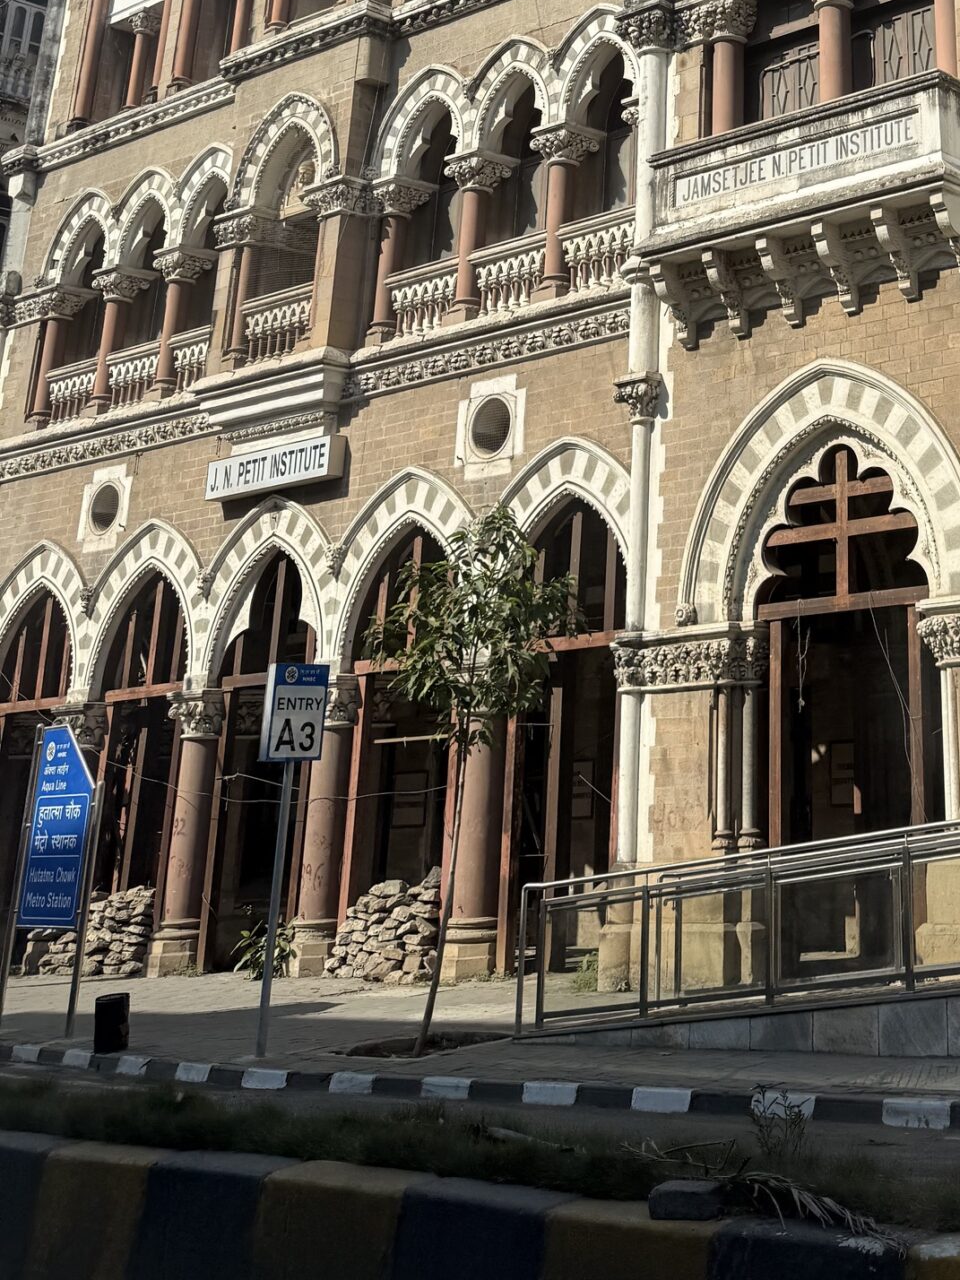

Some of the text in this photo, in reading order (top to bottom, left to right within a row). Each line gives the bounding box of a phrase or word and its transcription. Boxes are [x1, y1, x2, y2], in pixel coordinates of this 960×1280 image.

[682, 160, 766, 202] JAMSETJEE
[789, 141, 829, 174] PETIT
[835, 118, 913, 161] INSTITUTE
[210, 443, 326, 493] J. N. PETIT INSTITUTE
[277, 697, 323, 711] ENTRY
[274, 718, 316, 752] A3
[41, 780, 67, 792] Aqua Line
[37, 799, 82, 827] हुतात्मा चौक
[29, 867, 76, 882] Hutatma Chowk
[25, 892, 72, 908] Metro Station
